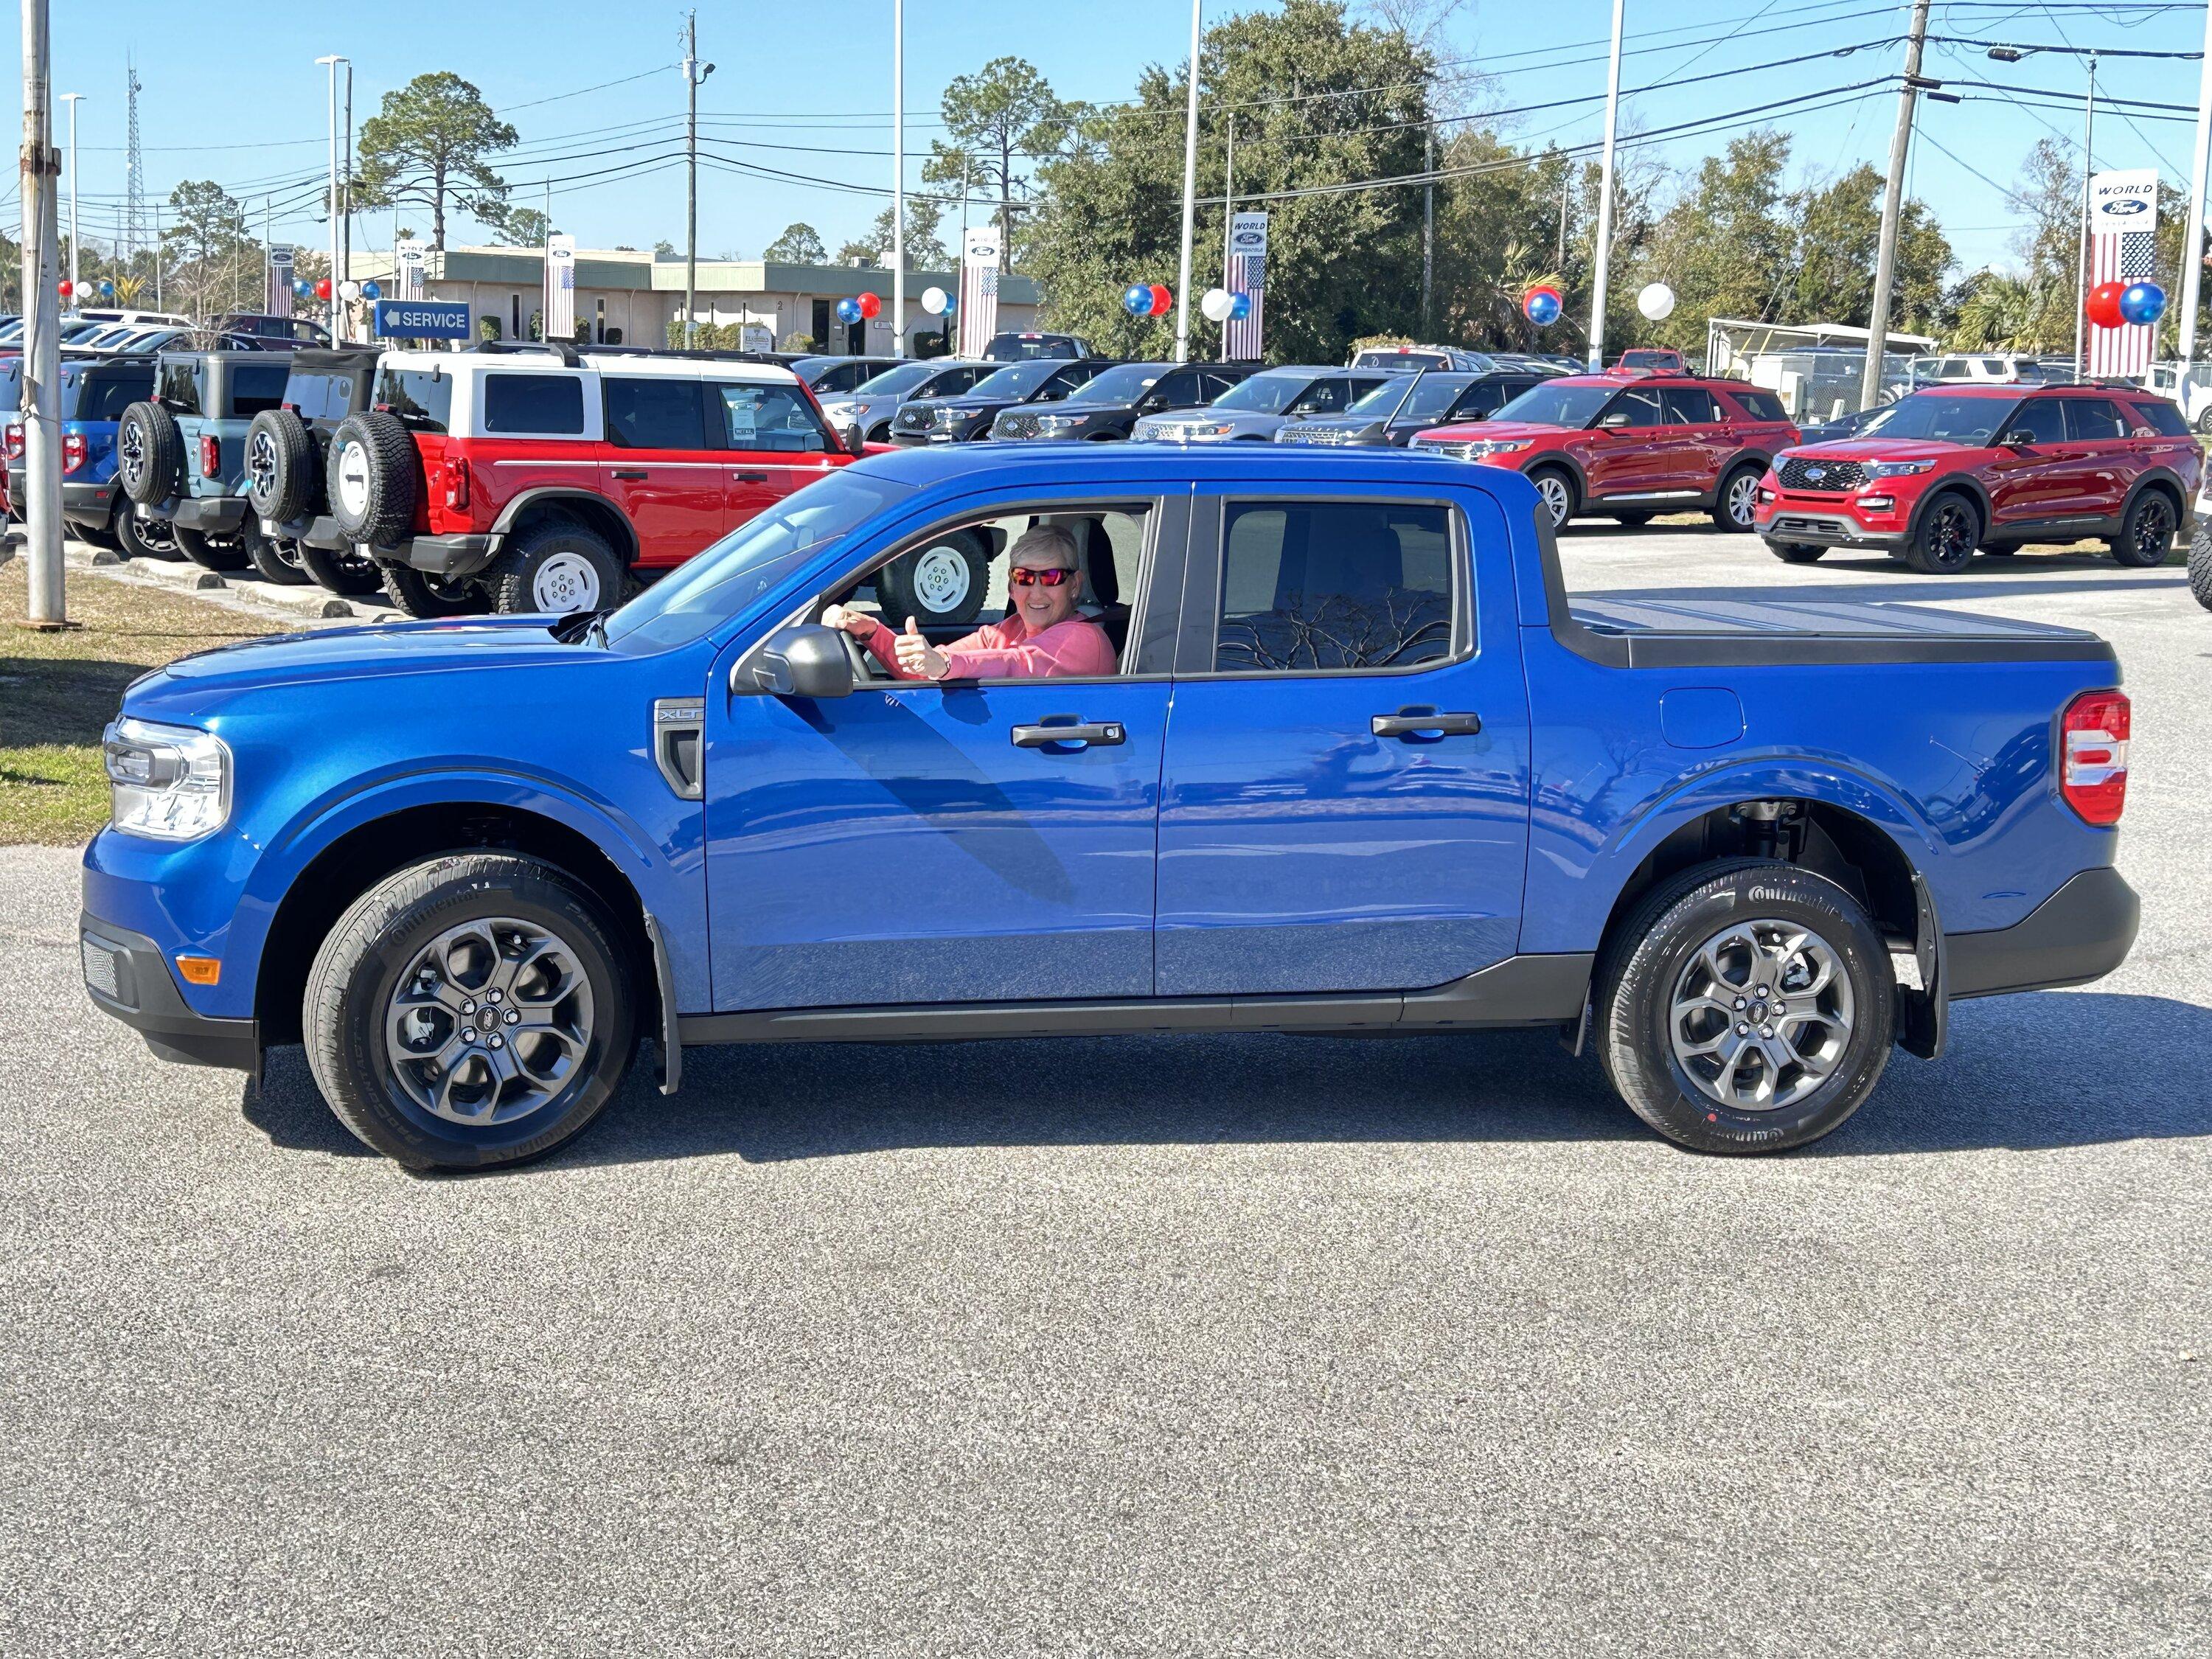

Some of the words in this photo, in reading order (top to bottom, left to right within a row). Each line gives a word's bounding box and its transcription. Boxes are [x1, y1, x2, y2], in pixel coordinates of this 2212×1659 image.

[2098, 184, 2152, 195] WORLD
[403, 311, 465, 328] SERVICE
[658, 710, 703, 720] XLT
